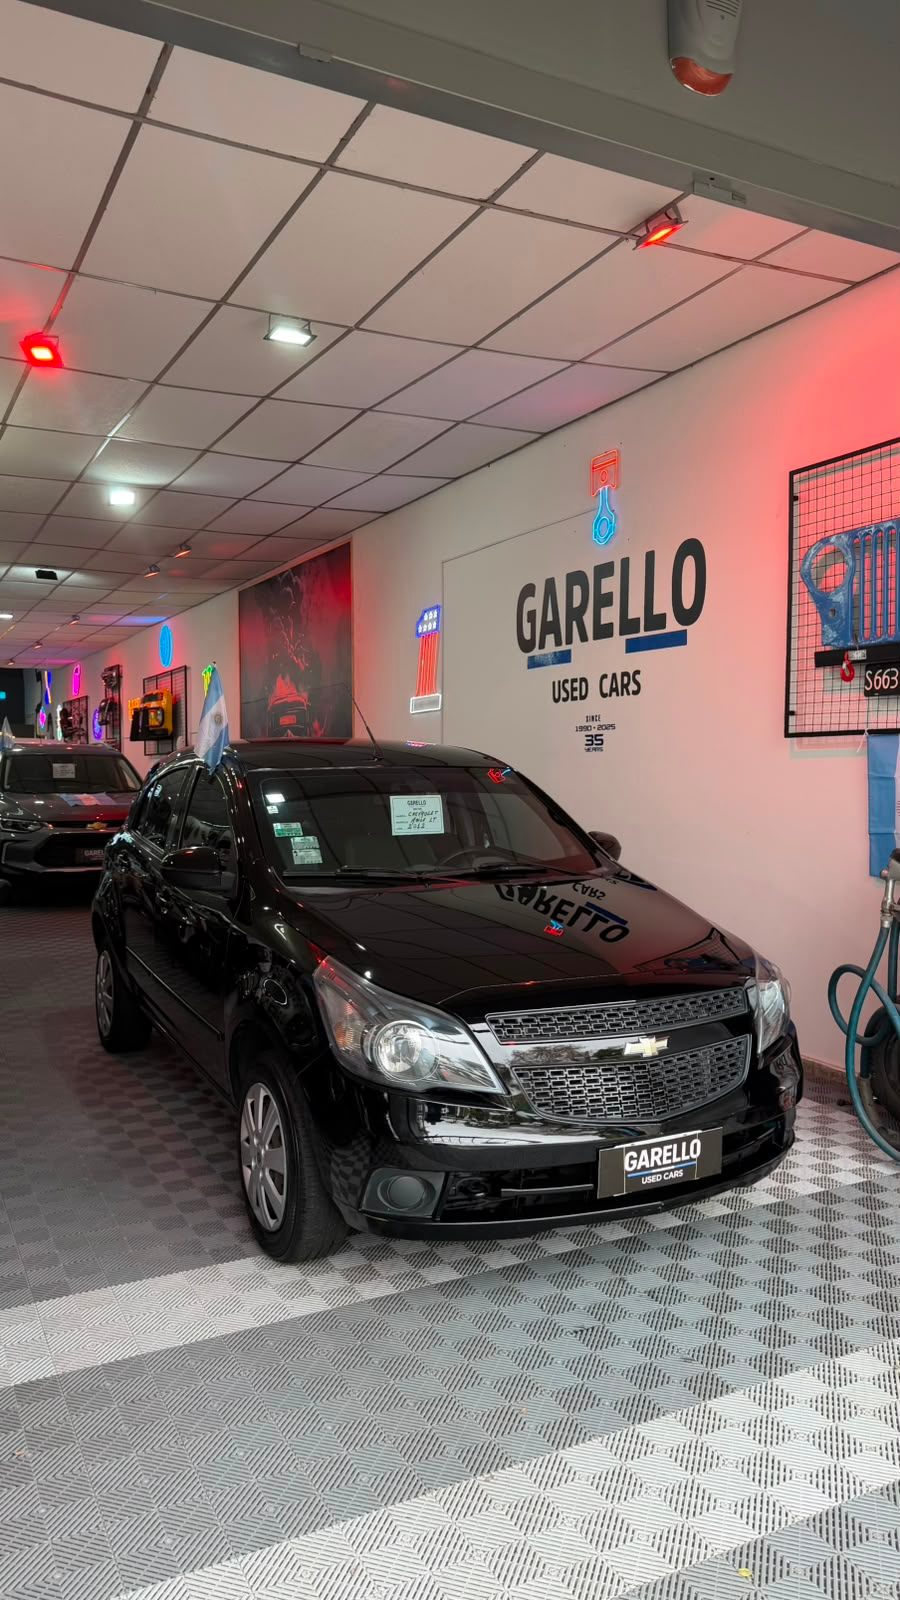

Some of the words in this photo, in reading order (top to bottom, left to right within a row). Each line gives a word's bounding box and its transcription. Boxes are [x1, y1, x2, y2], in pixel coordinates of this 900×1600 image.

[516, 538, 706, 653] GARELLO
[552, 677, 588, 703] USED
[600, 670, 641, 698] CARS
[864, 667, 899, 691] S663
[585, 714, 601, 723] SINCE
[597, 723, 616, 731] 2025
[584, 733, 604, 746] 35
[624, 1139, 701, 1171] GARELLO
[642, 1174, 662, 1184] USED
[663, 1170, 683, 1180] CARS
